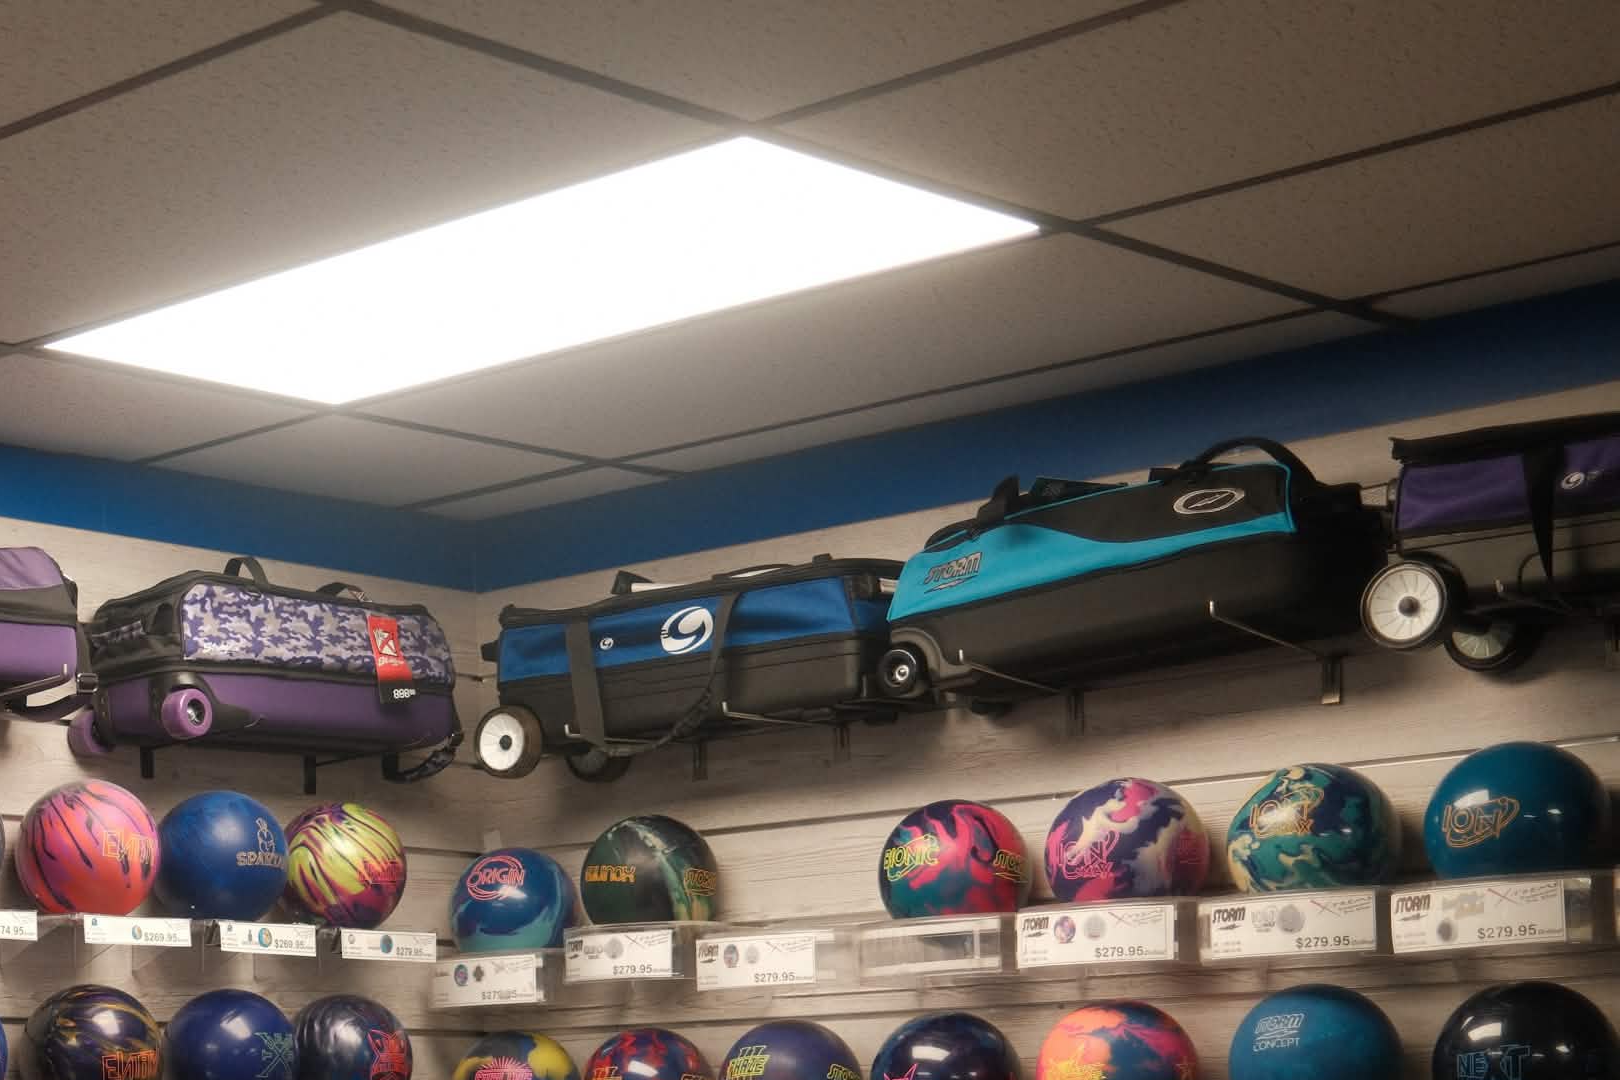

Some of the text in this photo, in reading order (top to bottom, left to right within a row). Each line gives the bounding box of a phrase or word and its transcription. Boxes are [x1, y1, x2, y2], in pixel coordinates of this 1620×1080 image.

[925, 554, 982, 584] STORM
[1443, 804, 1501, 837] ION
[884, 846, 939, 869] BIONIC
[468, 866, 525, 888] ORIGIN
[1395, 894, 1431, 913] STORM
[1212, 907, 1246, 923] STORM
[1022, 917, 1049, 931] STORM
[1477, 924, 1537, 939] $279.95
[1295, 936, 1350, 948] $279.95
[1095, 945, 1145, 957] $279.95
[613, 964, 653, 975] $279.95
[755, 971, 796, 982] $279.95
[1253, 1037, 1300, 1052] CONCEPT
